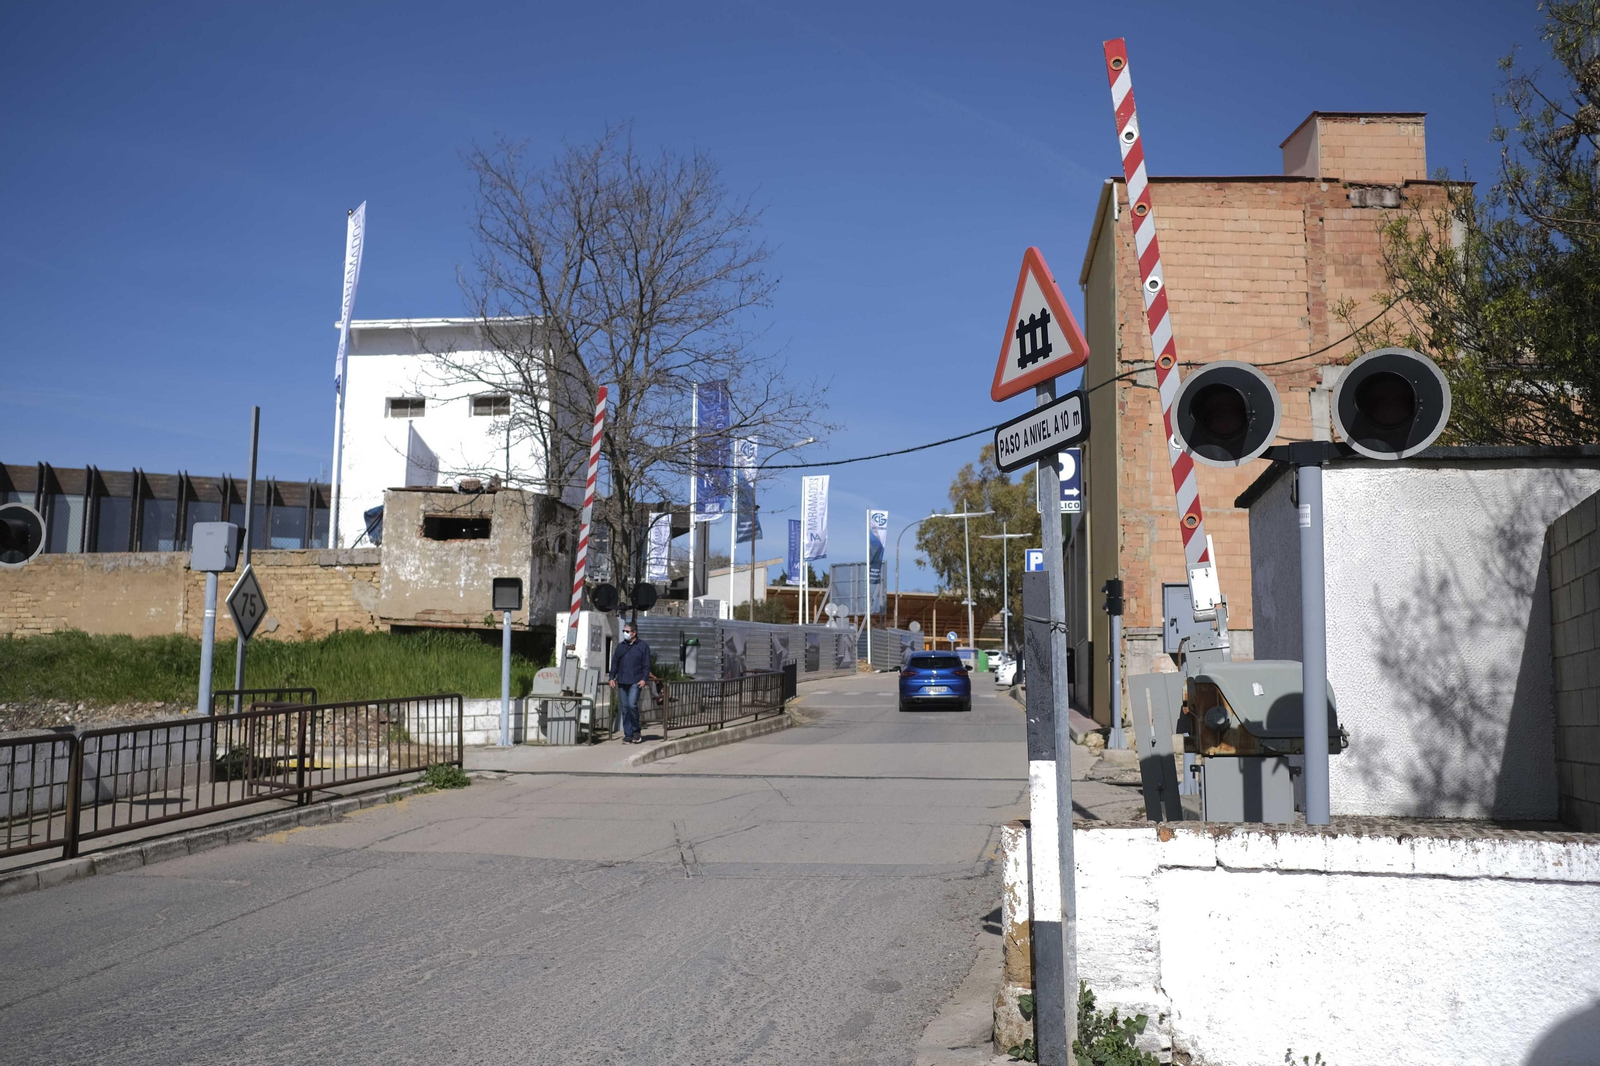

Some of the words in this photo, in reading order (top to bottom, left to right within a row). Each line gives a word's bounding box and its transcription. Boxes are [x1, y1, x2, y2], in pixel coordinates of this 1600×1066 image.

[999, 432, 1021, 458] PASO
[1023, 428, 1029, 448] A
[1029, 419, 1051, 444] NIVEL
[1054, 414, 1060, 436] A
[1060, 409, 1069, 432] 10
[1073, 410, 1080, 427] m
[808, 478, 819, 530] MARAMADOS
[1030, 553, 1043, 571] P
[241, 592, 256, 618] 75
